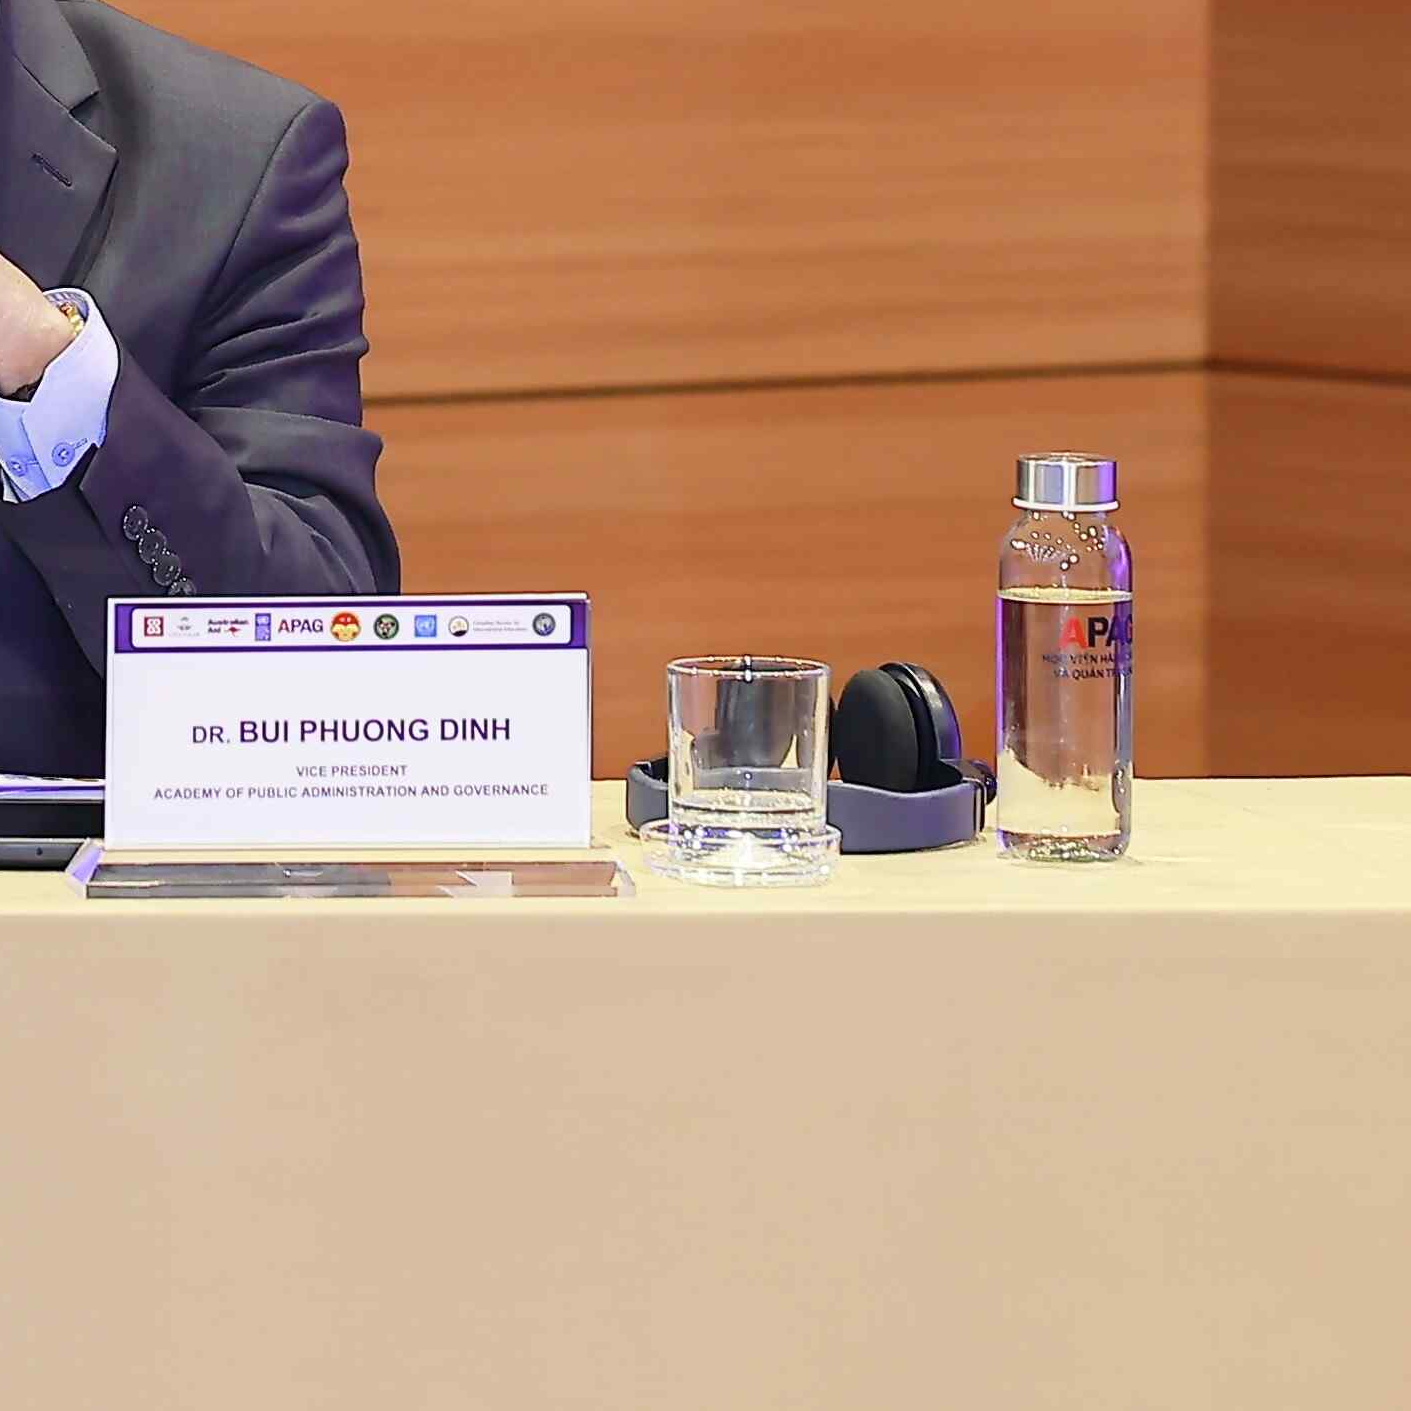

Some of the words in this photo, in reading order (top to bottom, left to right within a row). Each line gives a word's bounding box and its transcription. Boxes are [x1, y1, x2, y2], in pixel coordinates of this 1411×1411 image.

[278, 619, 324, 633] APAG
[191, 726, 232, 744] DR.
[239, 720, 289, 743] BUI
[299, 719, 430, 742] PHUONG
[440, 718, 511, 740] DINH
[296, 766, 327, 777] VICE
[331, 765, 408, 777] PRESIDENT
[154, 787, 222, 800] ACADEMY
[225, 787, 244, 799] OF
[248, 786, 298, 798] PUBLIC
[301, 785, 417, 798] ADMINISTRATION
[421, 785, 450, 797] AND
[453, 784, 549, 796] GOVERNANCE
